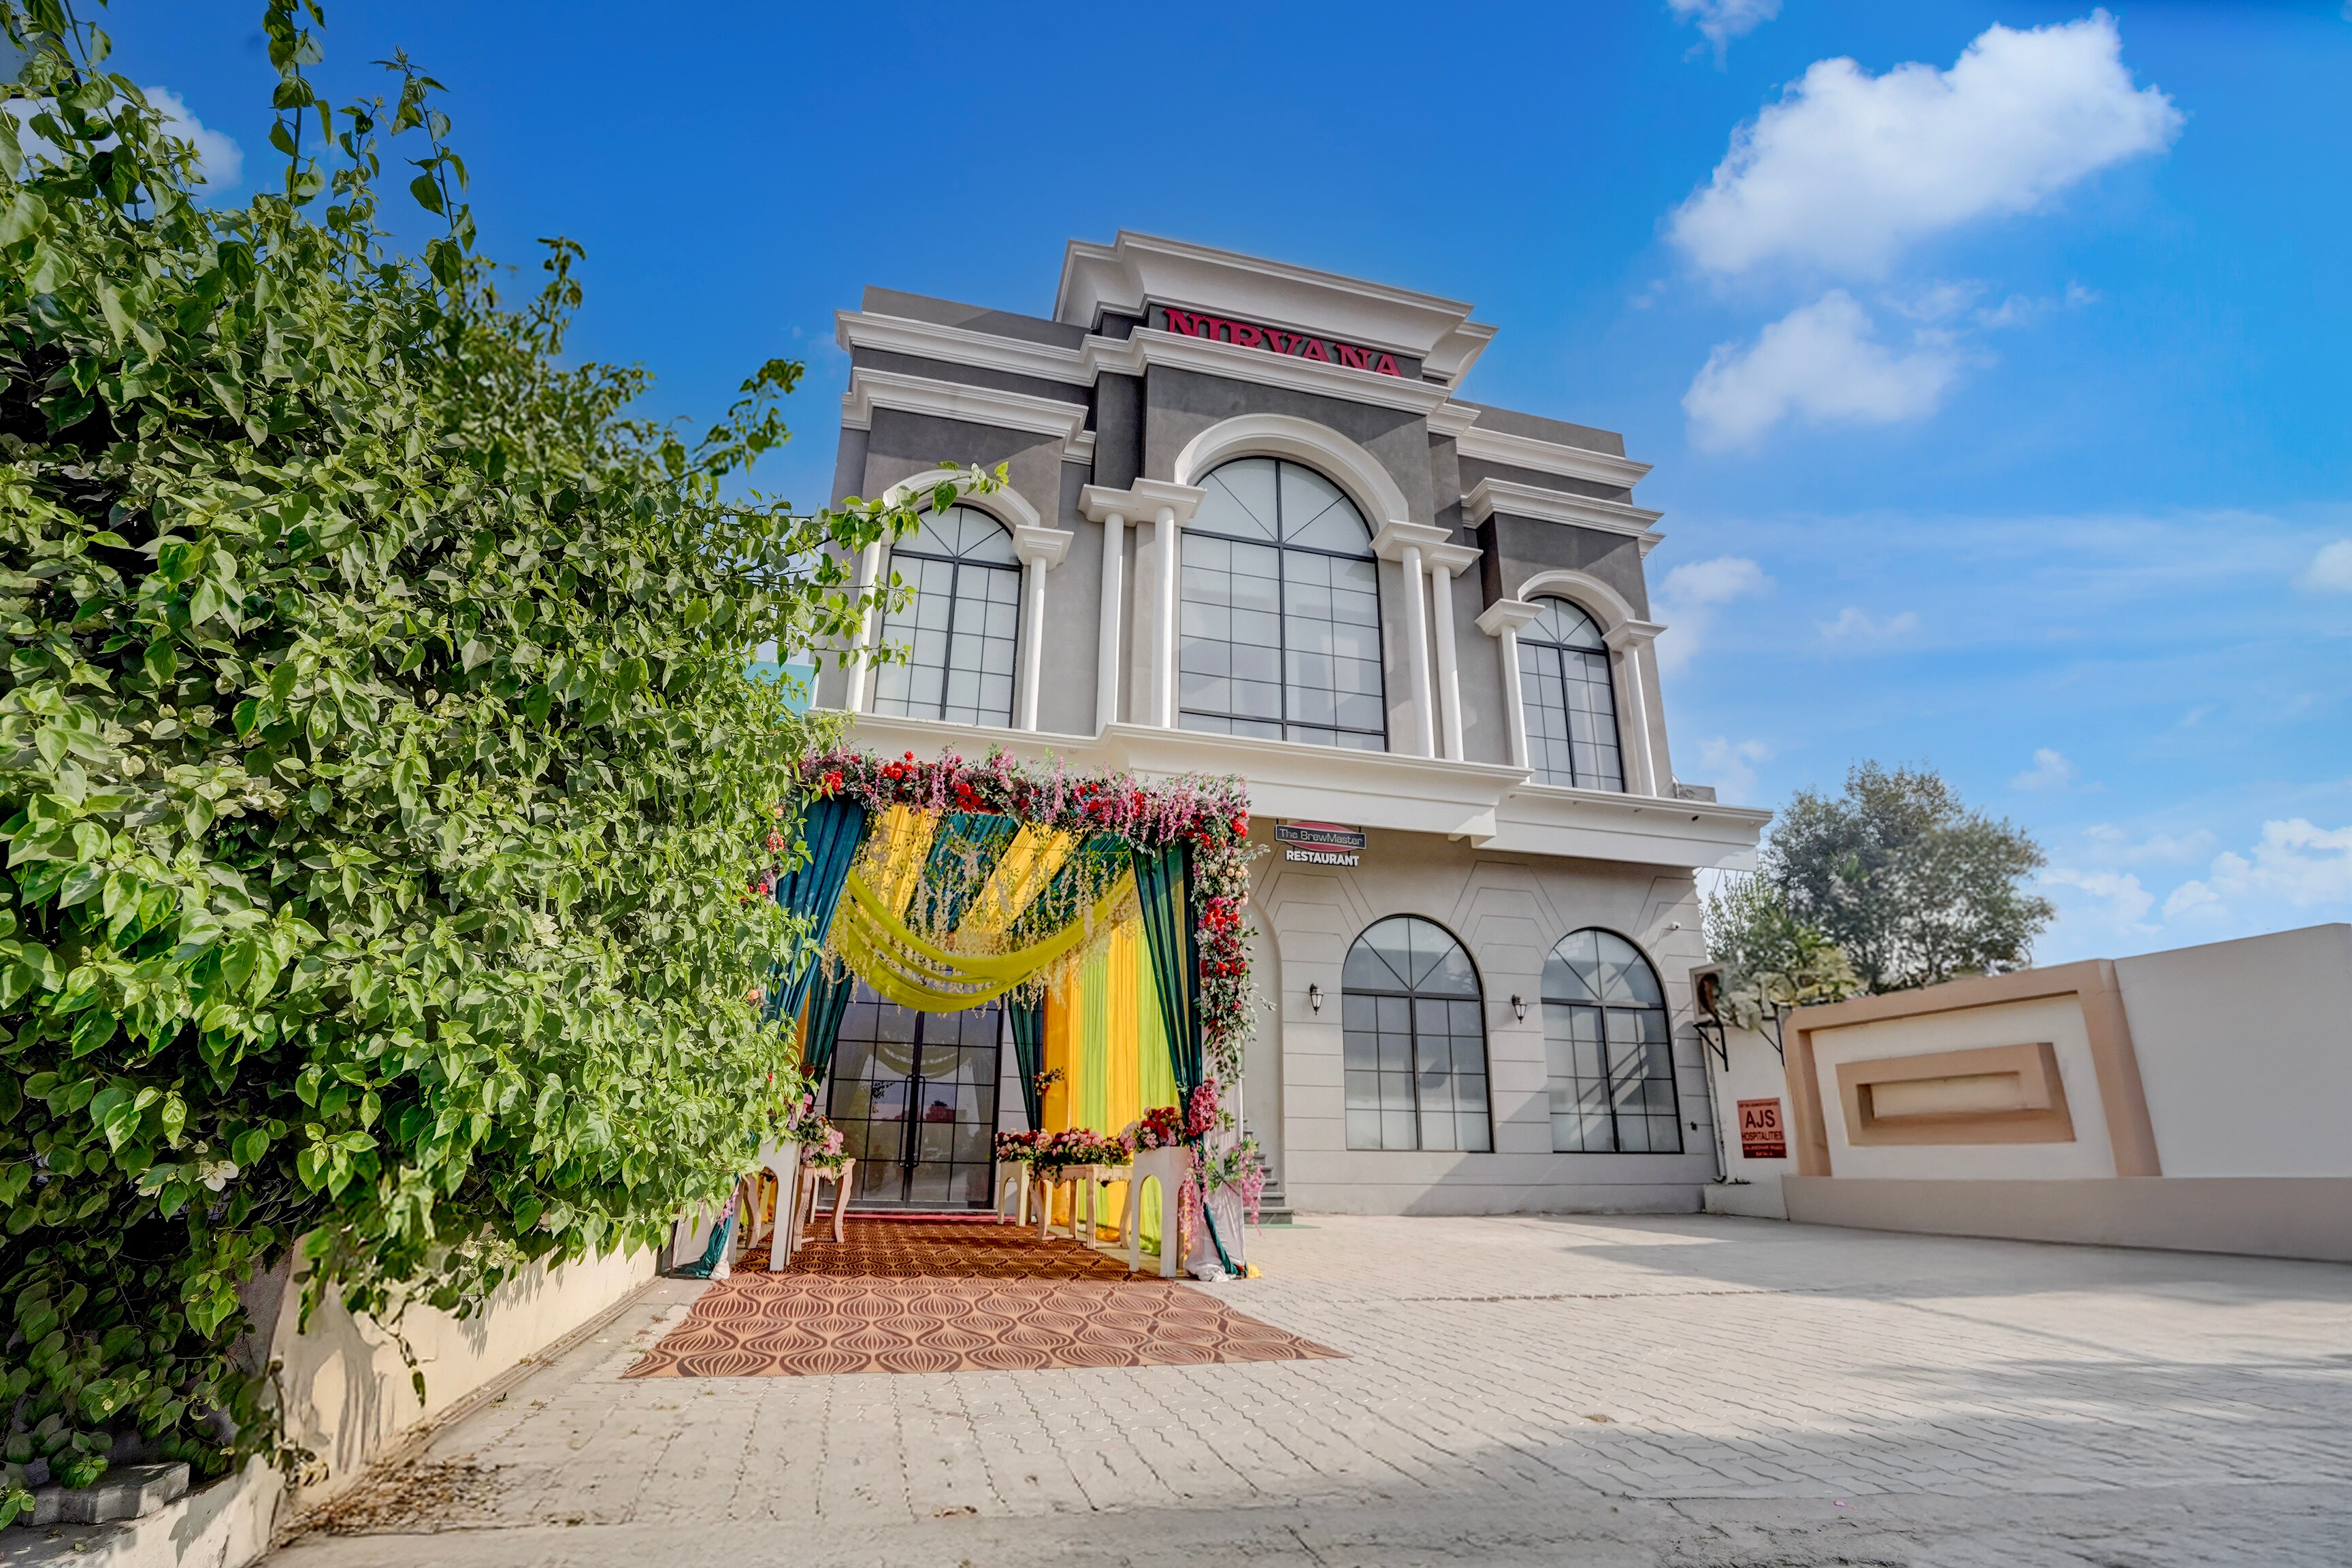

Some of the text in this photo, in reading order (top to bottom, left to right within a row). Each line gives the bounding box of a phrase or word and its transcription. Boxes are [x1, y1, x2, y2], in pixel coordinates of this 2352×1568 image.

[1164, 308, 1403, 377] NIRVANA
[1279, 828, 1363, 845] The BrewMaster
[1286, 850, 1360, 866] RESTAURANT
[1746, 1109, 1776, 1128] AJS
